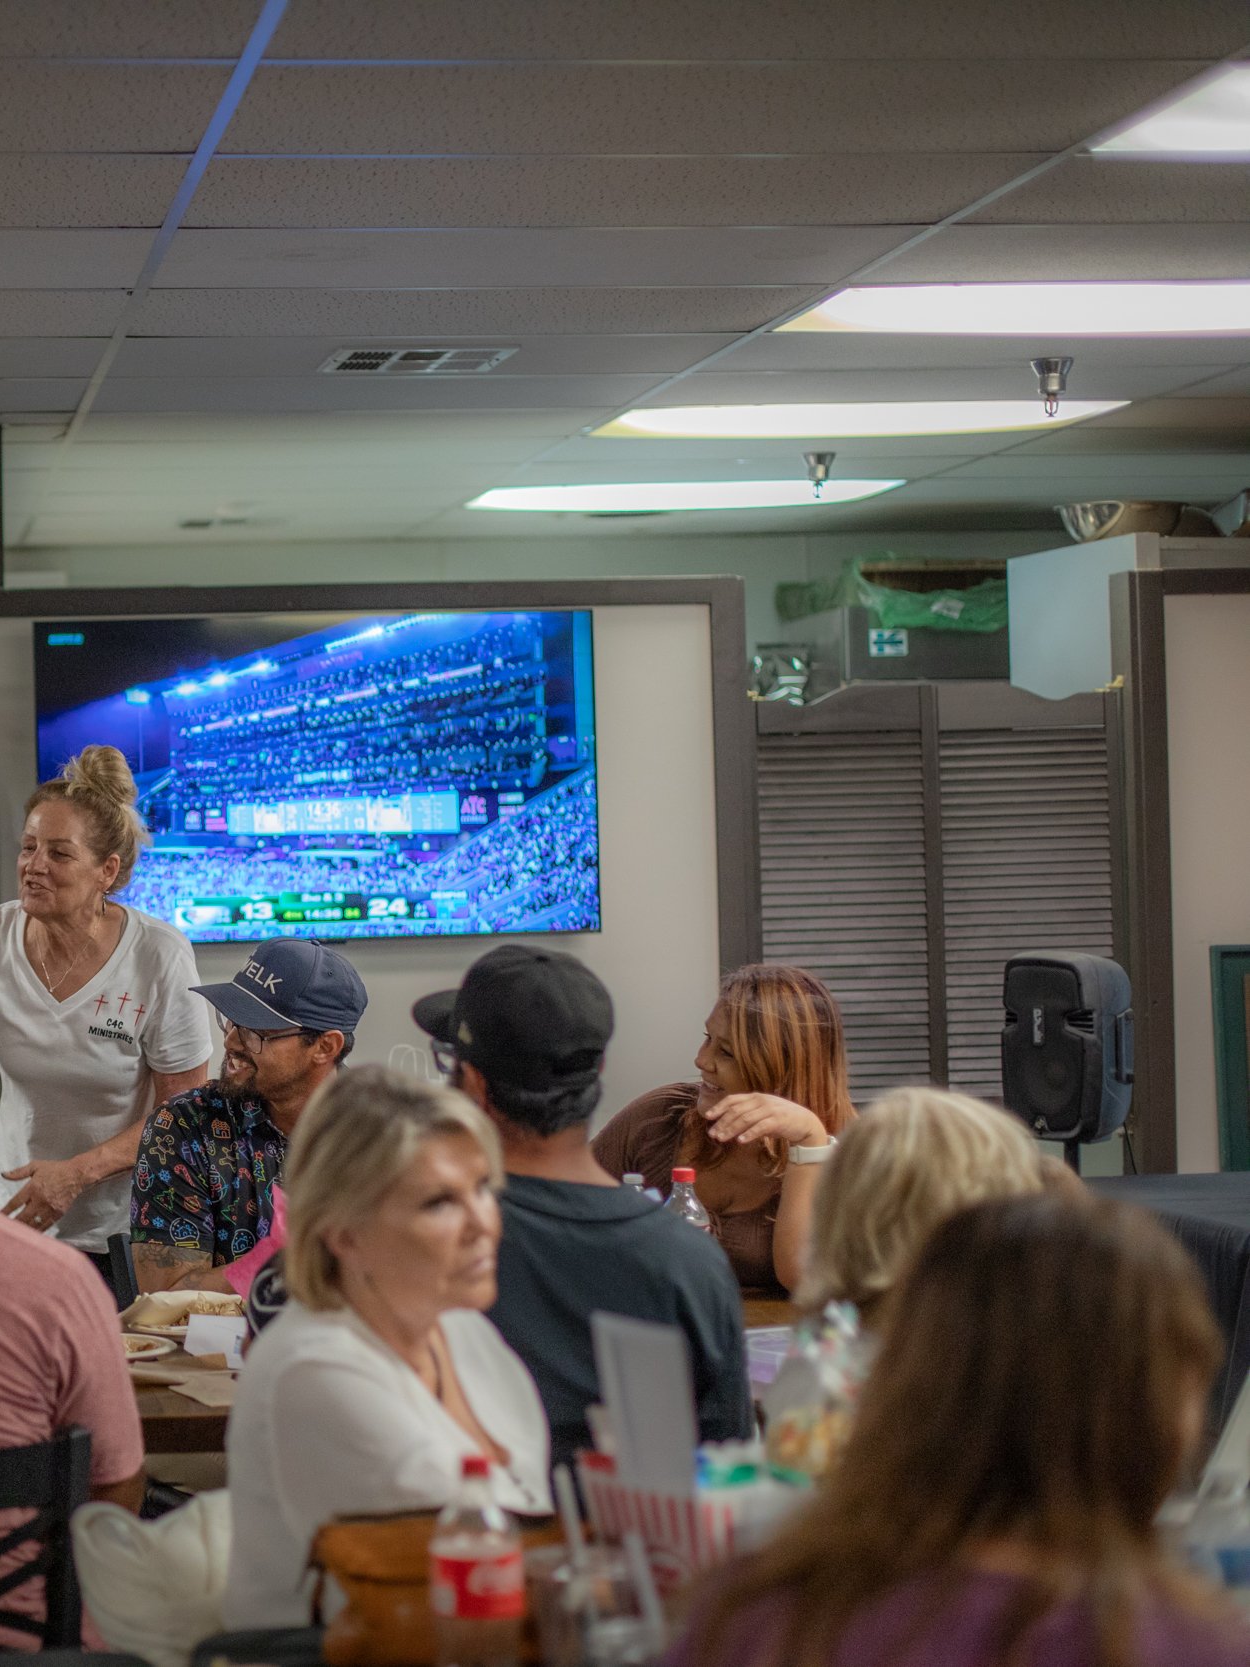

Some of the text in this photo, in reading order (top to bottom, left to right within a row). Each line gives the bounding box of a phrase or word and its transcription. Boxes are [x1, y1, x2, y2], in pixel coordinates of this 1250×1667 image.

[240, 900, 275, 921] 13
[367, 897, 409, 918] 24
[106, 1018, 124, 1030] C4C
[88, 1025, 134, 1045] MINISTRIES
